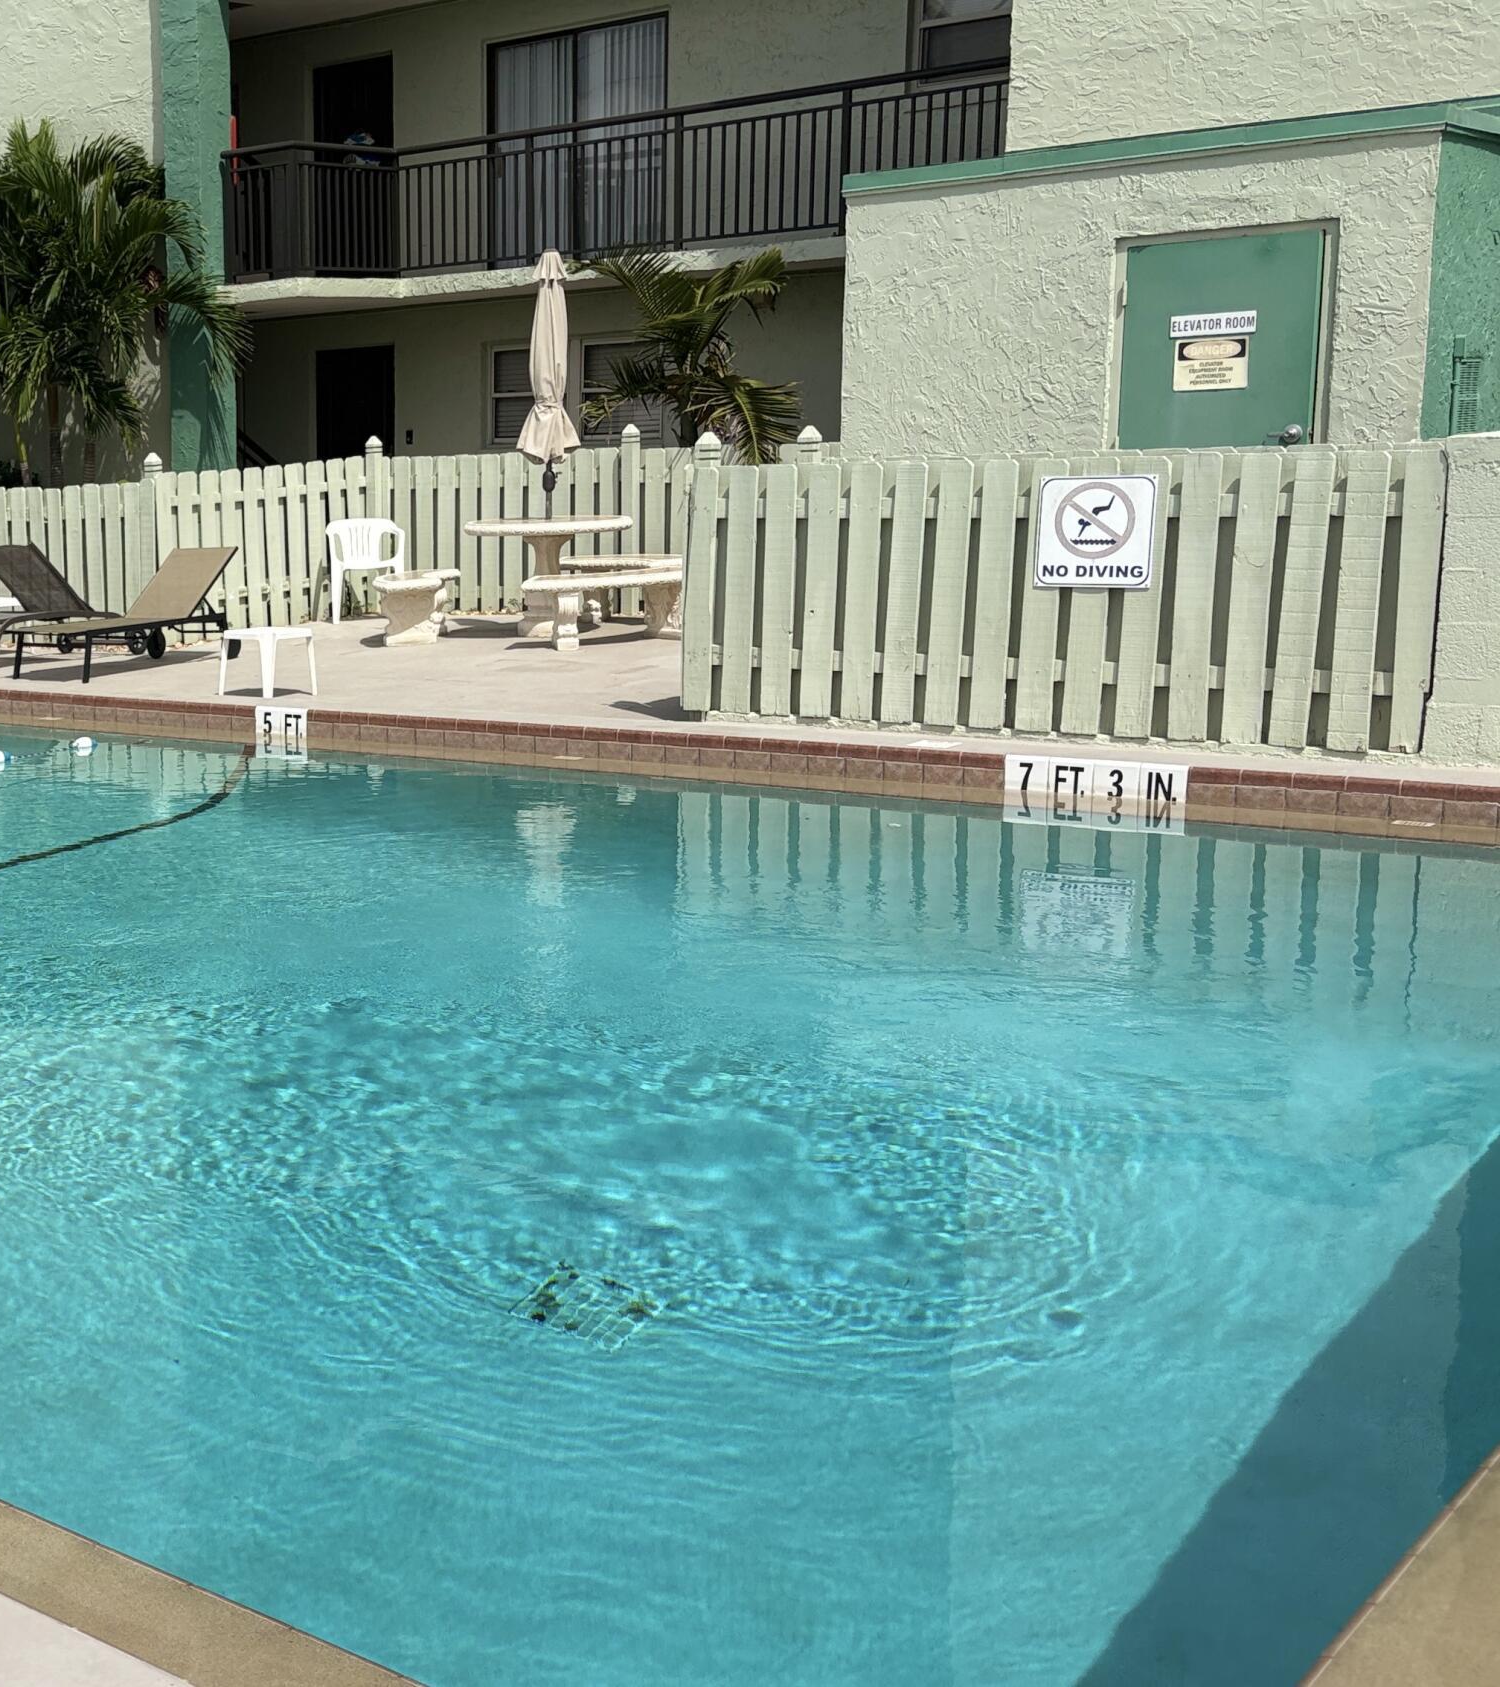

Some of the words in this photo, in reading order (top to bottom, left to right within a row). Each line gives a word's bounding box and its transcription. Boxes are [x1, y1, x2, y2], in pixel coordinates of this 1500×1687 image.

[1172, 318, 1222, 332] ELEVATOR
[1225, 316, 1255, 329] ROOM
[1190, 344, 1233, 356] DANGER
[1042, 565, 1068, 577] NO
[1075, 565, 1144, 578] DIVING
[263, 712, 272, 734] 5
[284, 713, 303, 737] FT.
[1019, 762, 1033, 791] 7
[1054, 765, 1084, 796] FT.
[1107, 769, 1123, 798] 3
[1146, 771, 1177, 802] IN.
